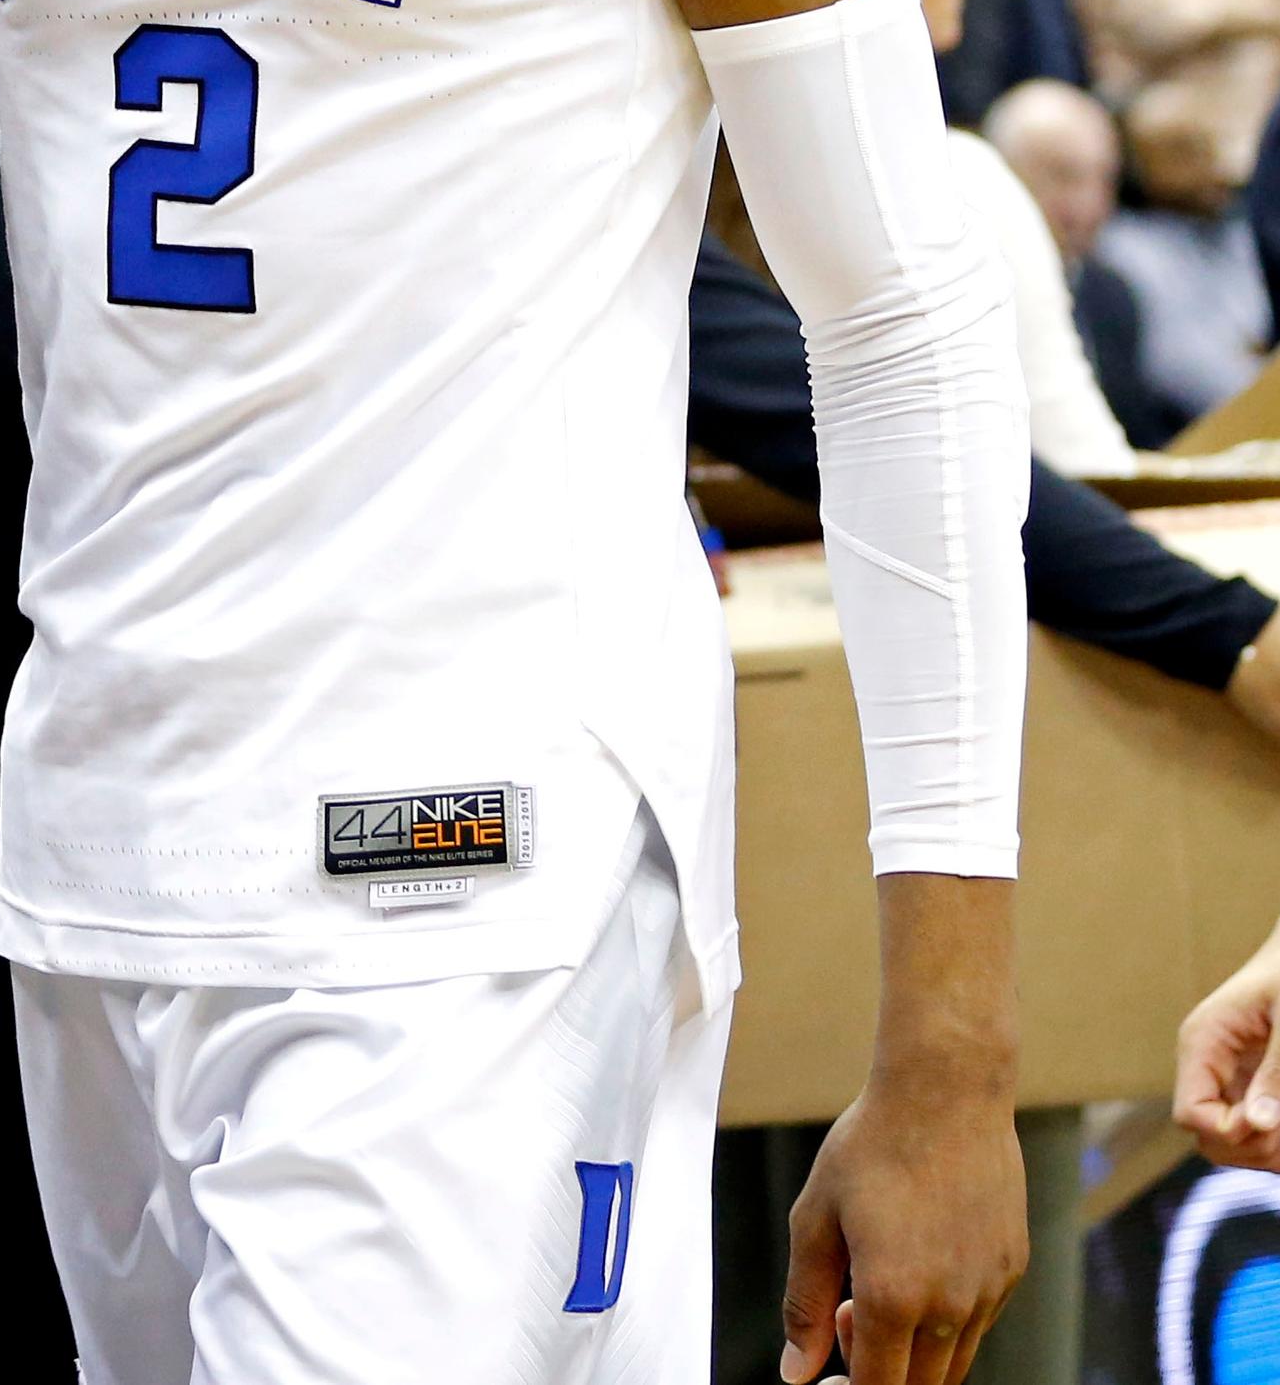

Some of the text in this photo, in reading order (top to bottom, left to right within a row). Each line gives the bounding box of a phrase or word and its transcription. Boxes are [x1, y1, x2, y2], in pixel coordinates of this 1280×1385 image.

[106, 23, 260, 314] 2
[412, 794, 502, 823] NIKE
[334, 805, 407, 847] 44
[413, 819, 504, 850] ELITE
[337, 859, 368, 869] OFFICIAL
[369, 856, 401, 866] MEMBER
[402, 855, 412, 864] OF
[413, 854, 428, 862] THE
[429, 853, 446, 862] NIKE
[446, 851, 466, 861] ELITE
